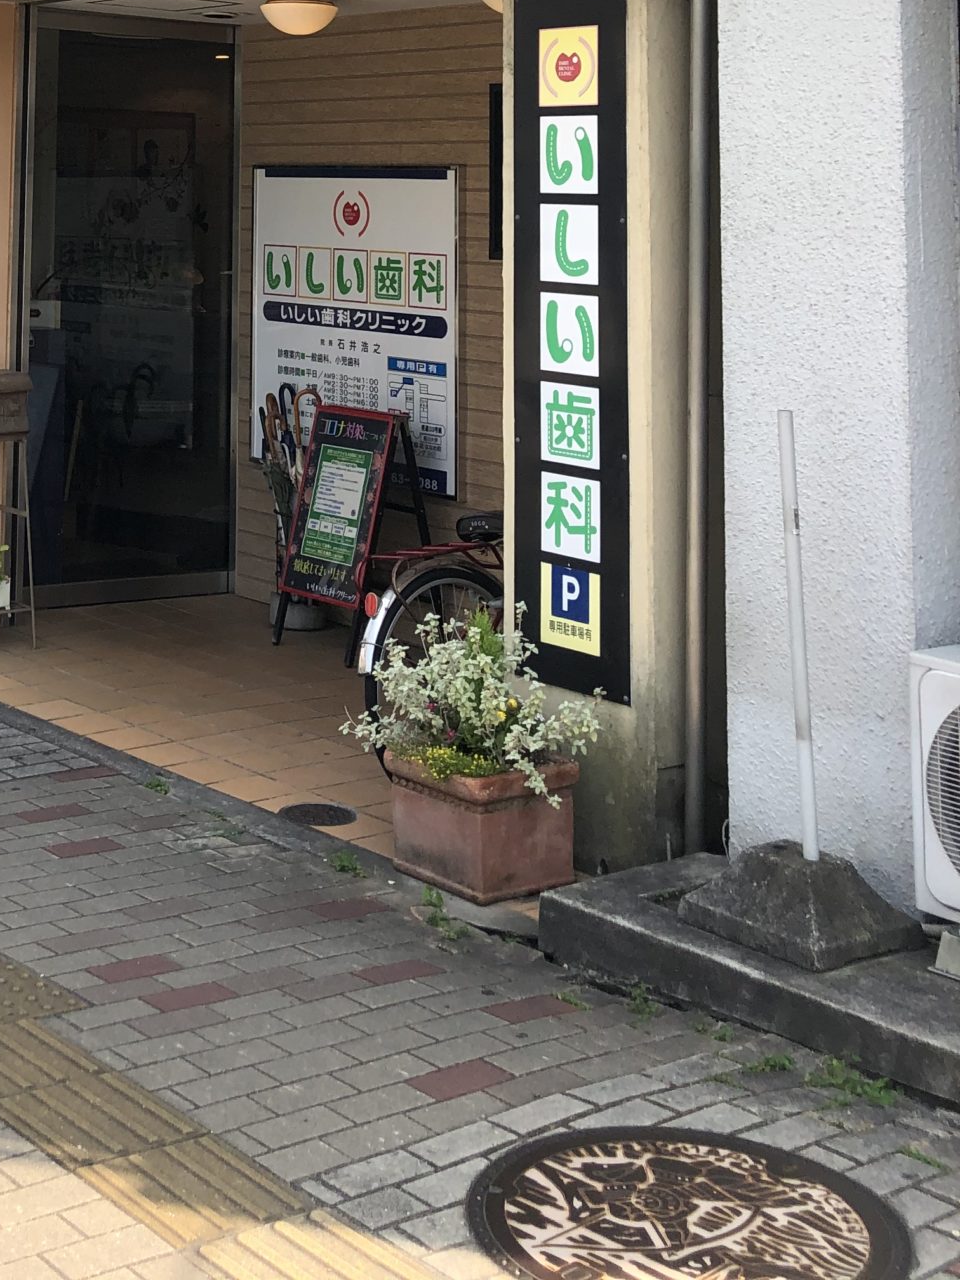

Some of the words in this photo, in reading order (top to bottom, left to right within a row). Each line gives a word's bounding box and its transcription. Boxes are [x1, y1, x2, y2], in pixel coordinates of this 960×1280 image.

[266, 251, 444, 304] いしい歯科
[280, 304, 427, 334] いしい歯科クリニック
[544, 123, 597, 554] いしい歯科
[561, 574, 580, 612] P
